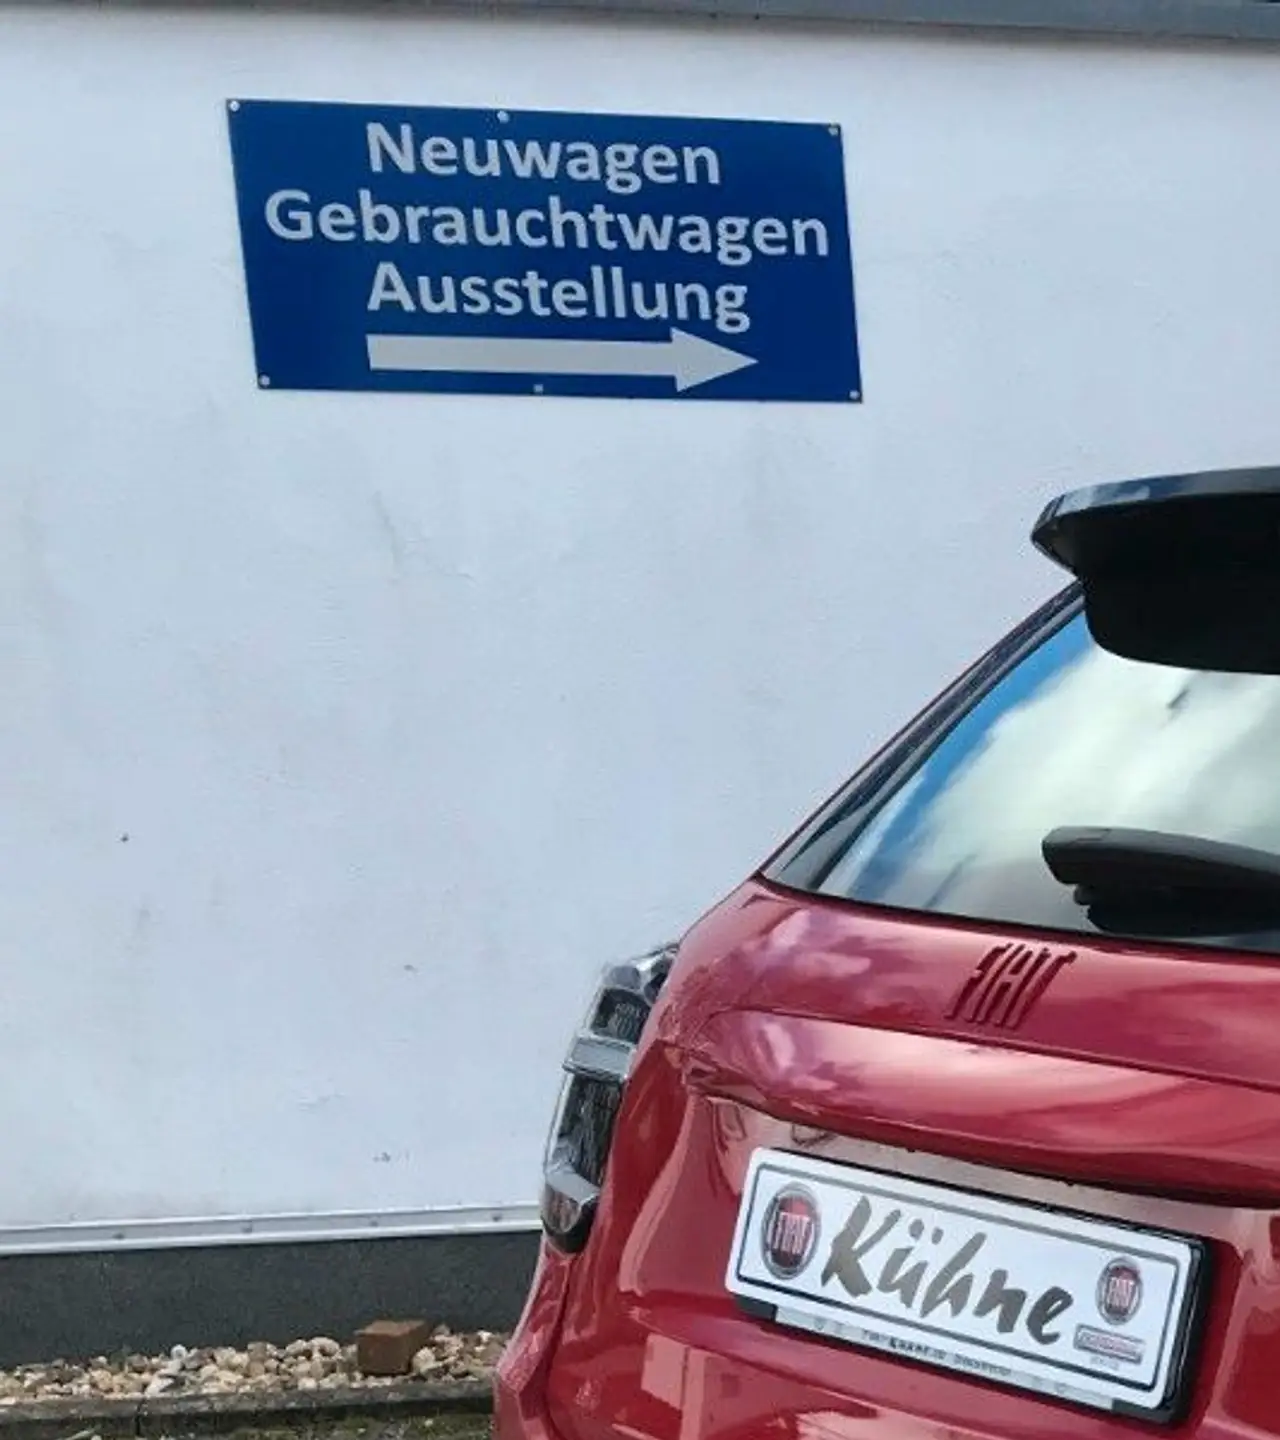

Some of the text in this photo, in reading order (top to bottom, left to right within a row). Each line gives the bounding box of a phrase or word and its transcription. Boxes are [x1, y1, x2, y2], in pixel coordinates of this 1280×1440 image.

[366, 121, 720, 195] Neuwagen
[263, 188, 830, 267] Gebrauchtwagen
[366, 261, 751, 334] Ausstellung
[820, 1195, 1074, 1346] Kühne
